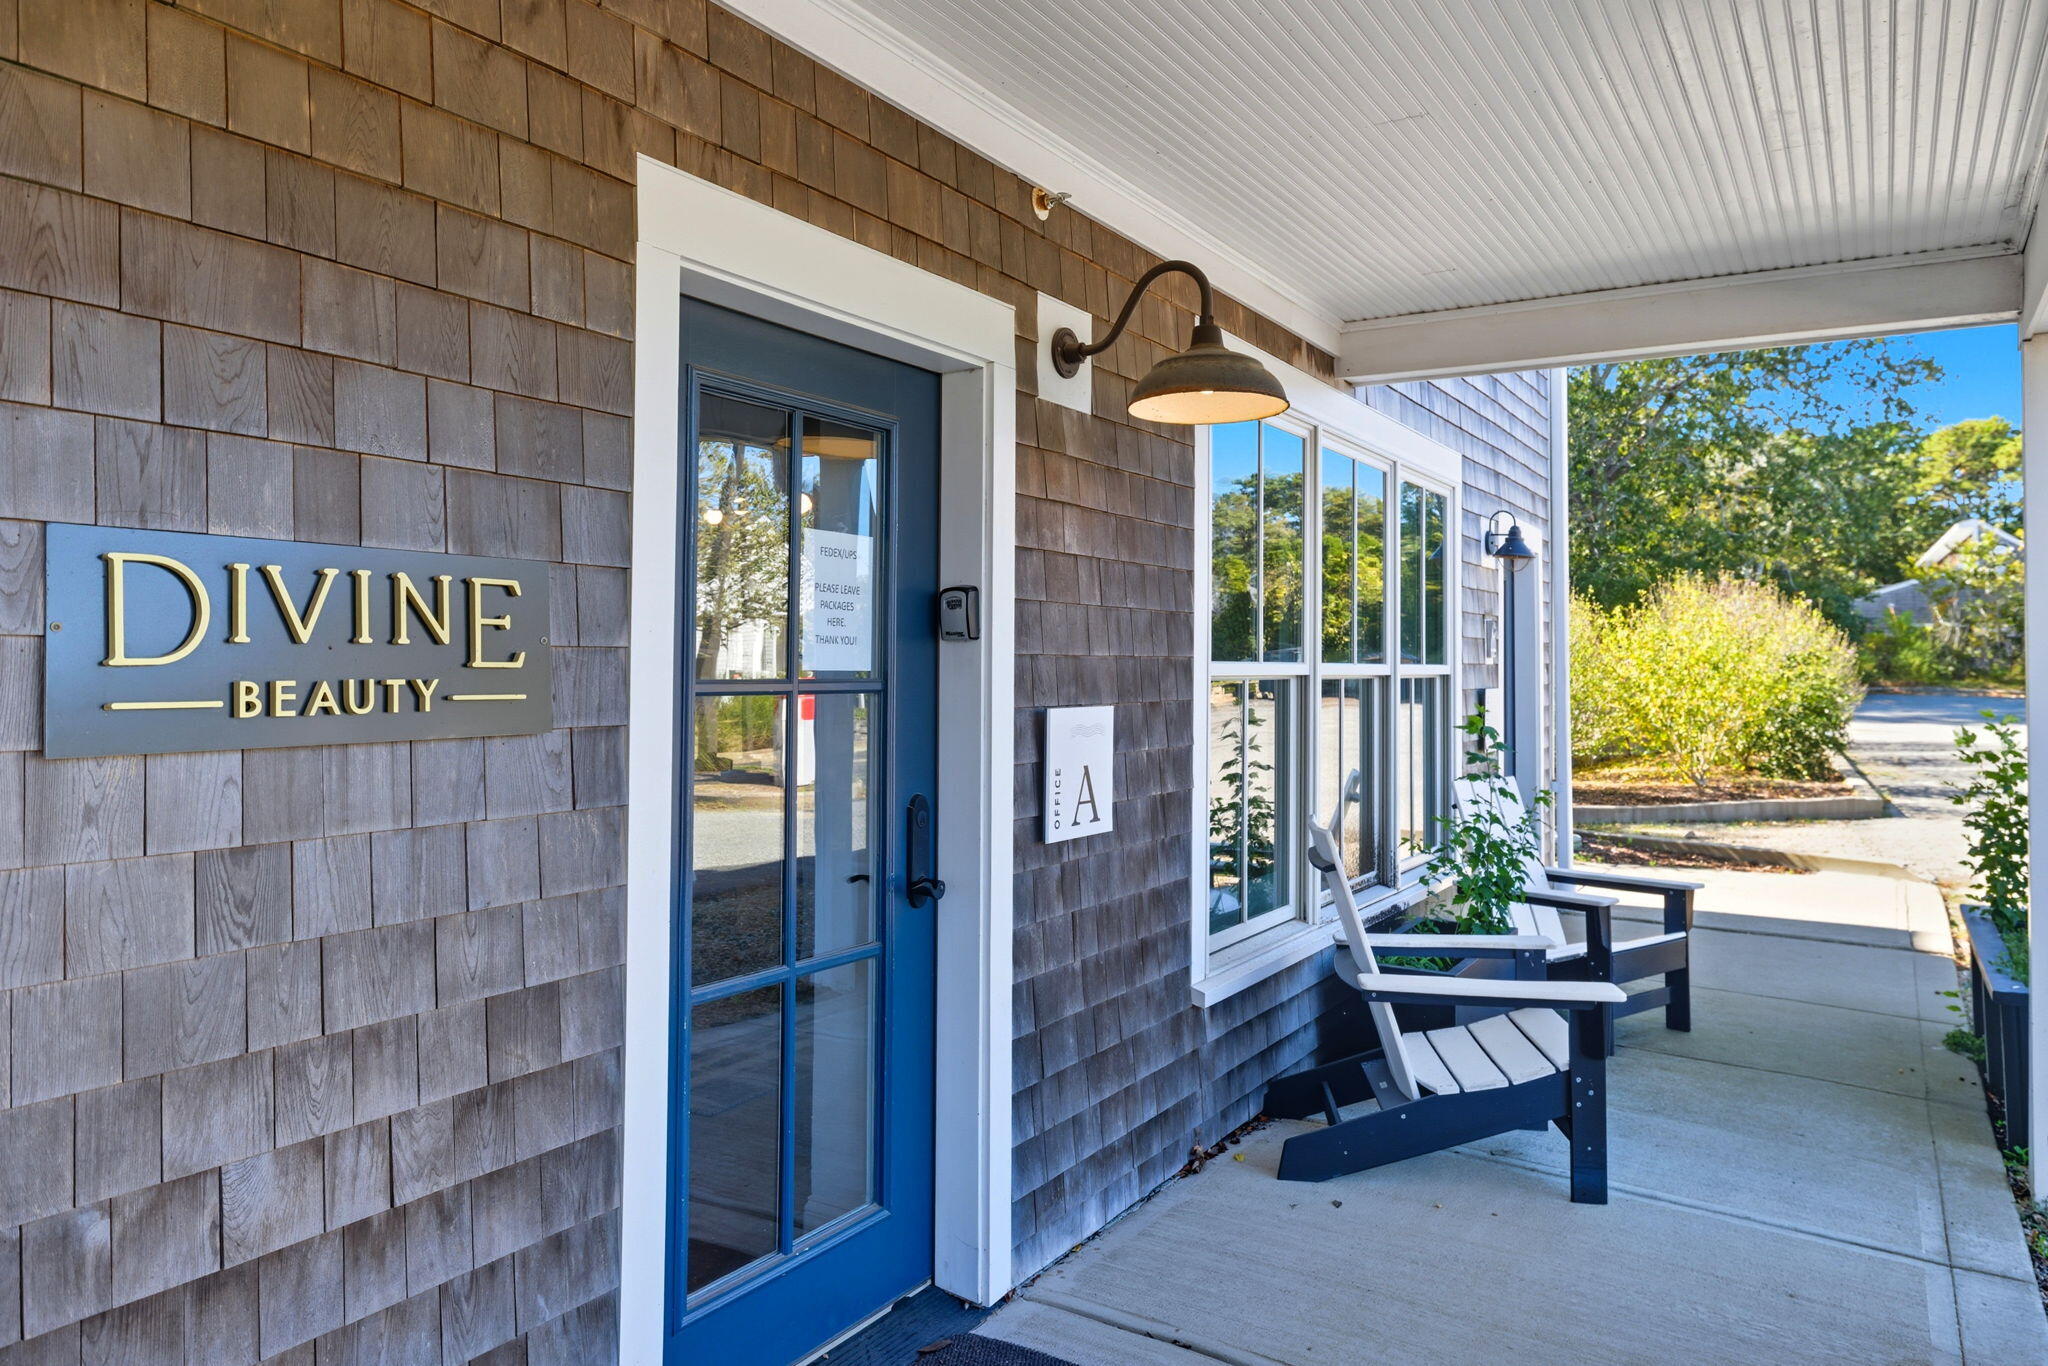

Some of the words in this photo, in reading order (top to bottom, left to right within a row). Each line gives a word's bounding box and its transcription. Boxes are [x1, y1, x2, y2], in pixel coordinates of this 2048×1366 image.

[820, 546, 857, 560] FEDEX/UPS
[815, 582, 839, 594] PLEASE
[840, 584, 860, 596] LEAVE
[101, 551, 526, 668] DIVINE
[820, 600, 854, 612] PACKAGES
[815, 634, 839, 645] THANK
[840, 635, 857, 646] YOU!
[233, 678, 440, 719] BEAUTY
[1054, 768, 1062, 830] OFFICE
[1071, 765, 1101, 827] A
